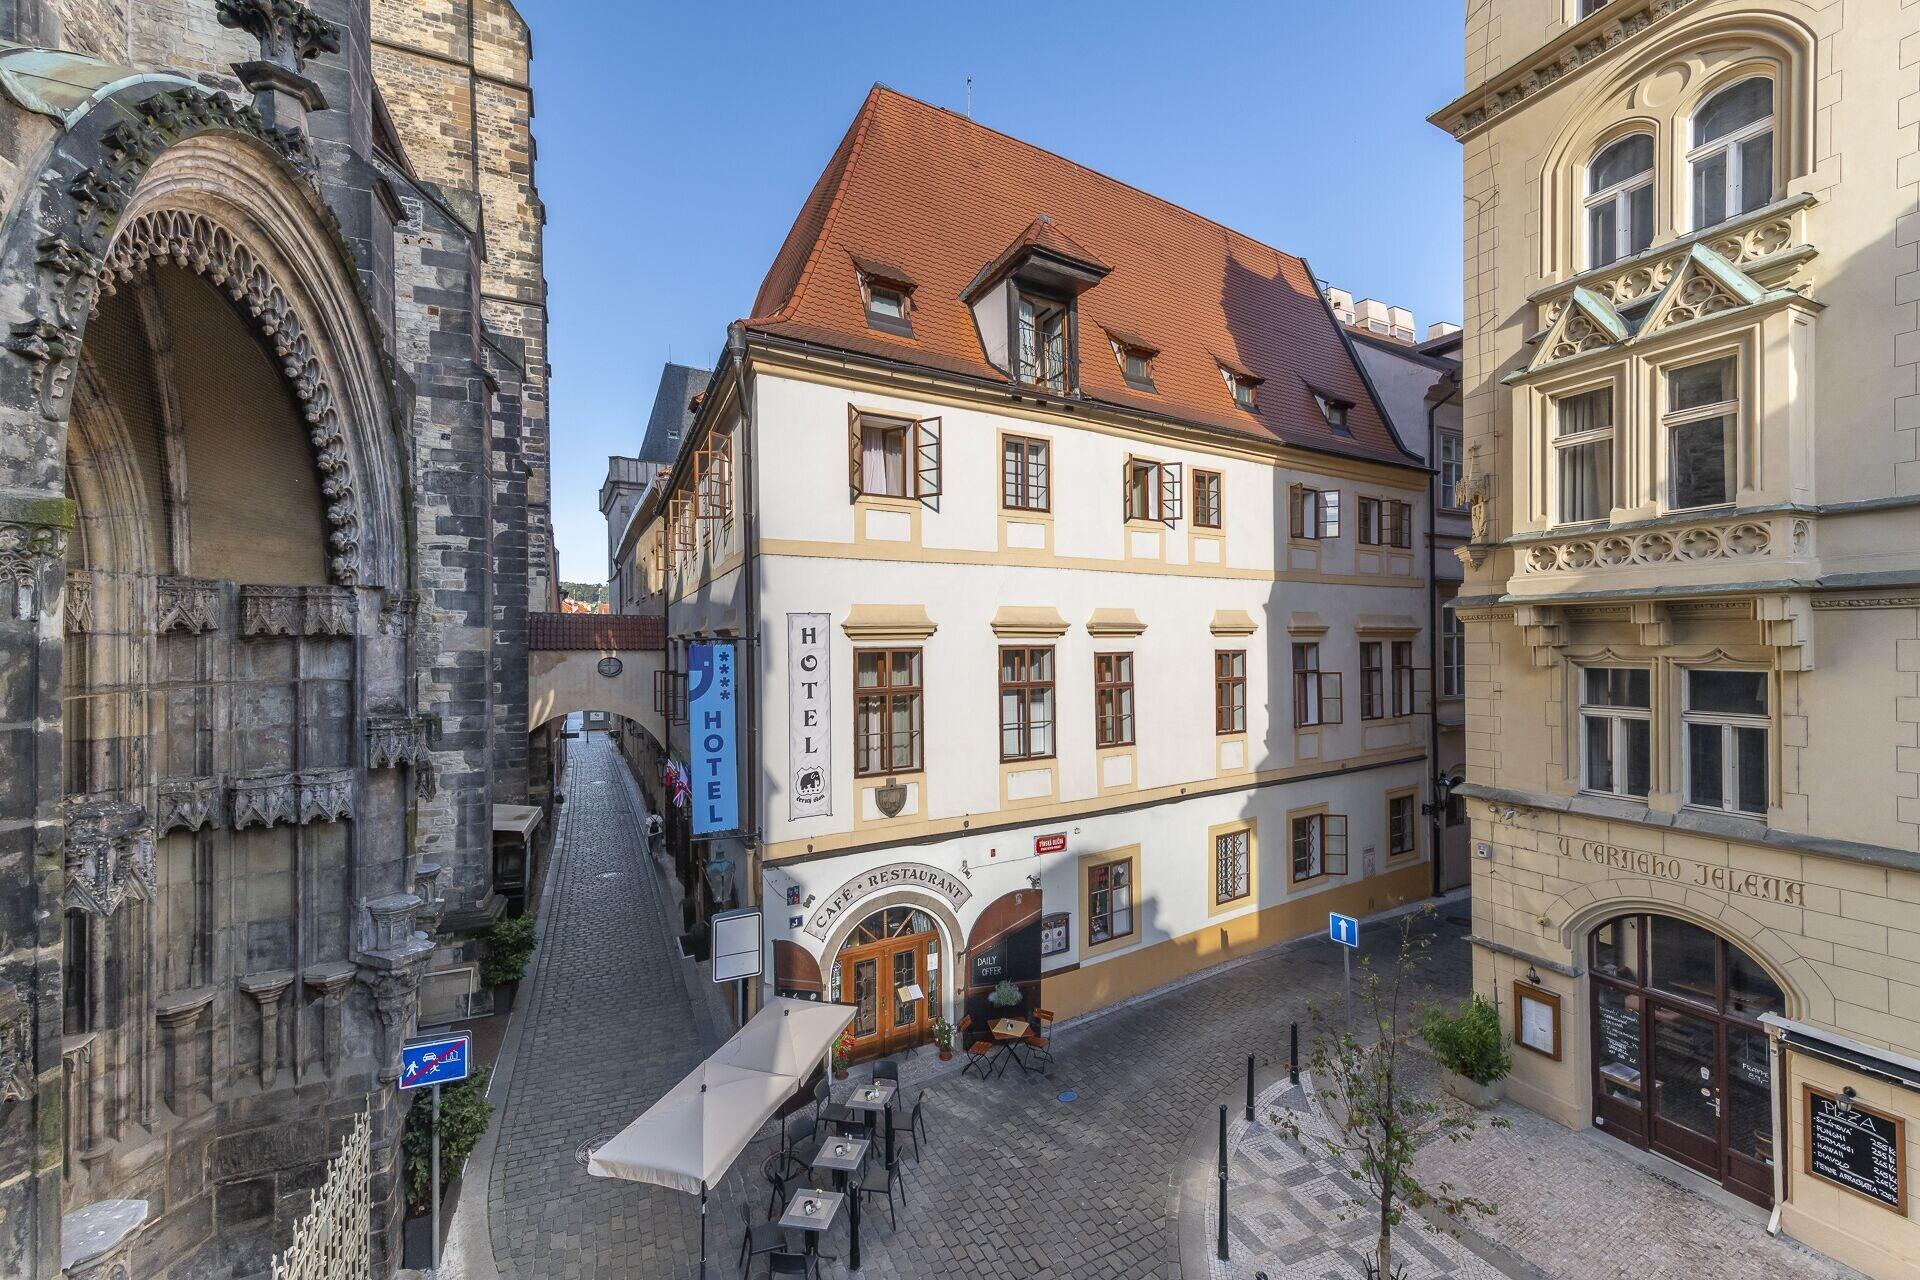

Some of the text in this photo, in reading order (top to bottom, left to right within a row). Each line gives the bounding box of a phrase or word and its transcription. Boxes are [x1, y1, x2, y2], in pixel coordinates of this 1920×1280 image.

[801, 627, 818, 754] HOTEL
[703, 711, 724, 823] HOTEL
[816, 888, 853, 929] CAFÉ
[868, 868, 963, 899] RESTAURANT
[1557, 836, 1571, 857] U
[1693, 863, 1807, 907] JELENA
[977, 956, 997, 967] DAILY
[981, 966, 1002, 976] OFFER
